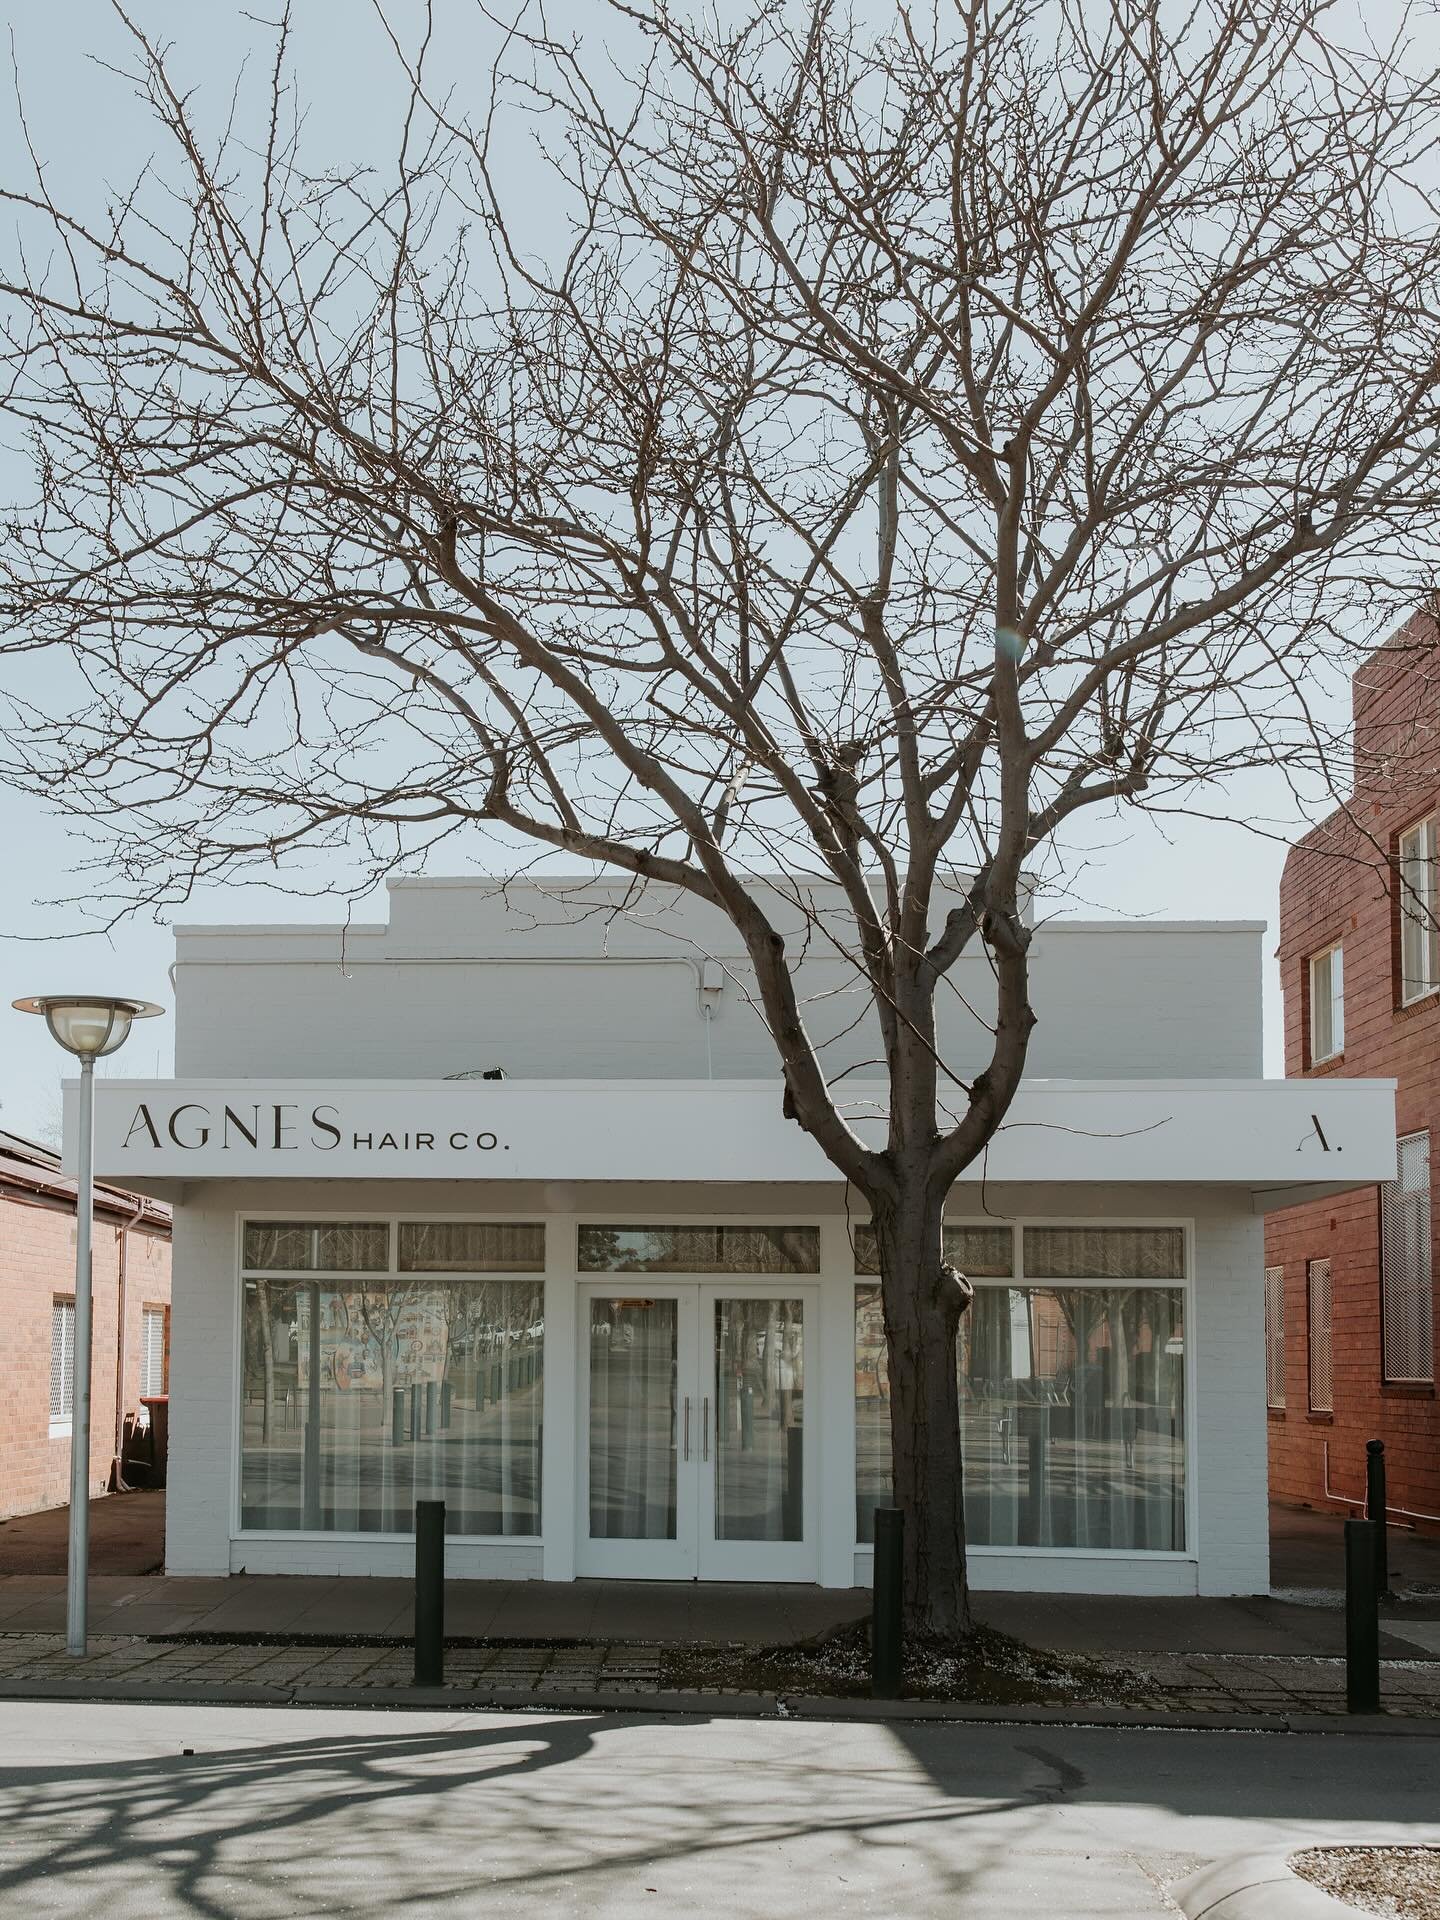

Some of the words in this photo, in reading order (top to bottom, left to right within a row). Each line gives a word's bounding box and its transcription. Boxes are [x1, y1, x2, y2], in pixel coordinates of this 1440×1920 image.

[121, 1104, 342, 1151] AGNES
[353, 1132, 435, 1151] HAIR
[449, 1132, 511, 1151] CO.
[1295, 1114, 1343, 1152] A.
